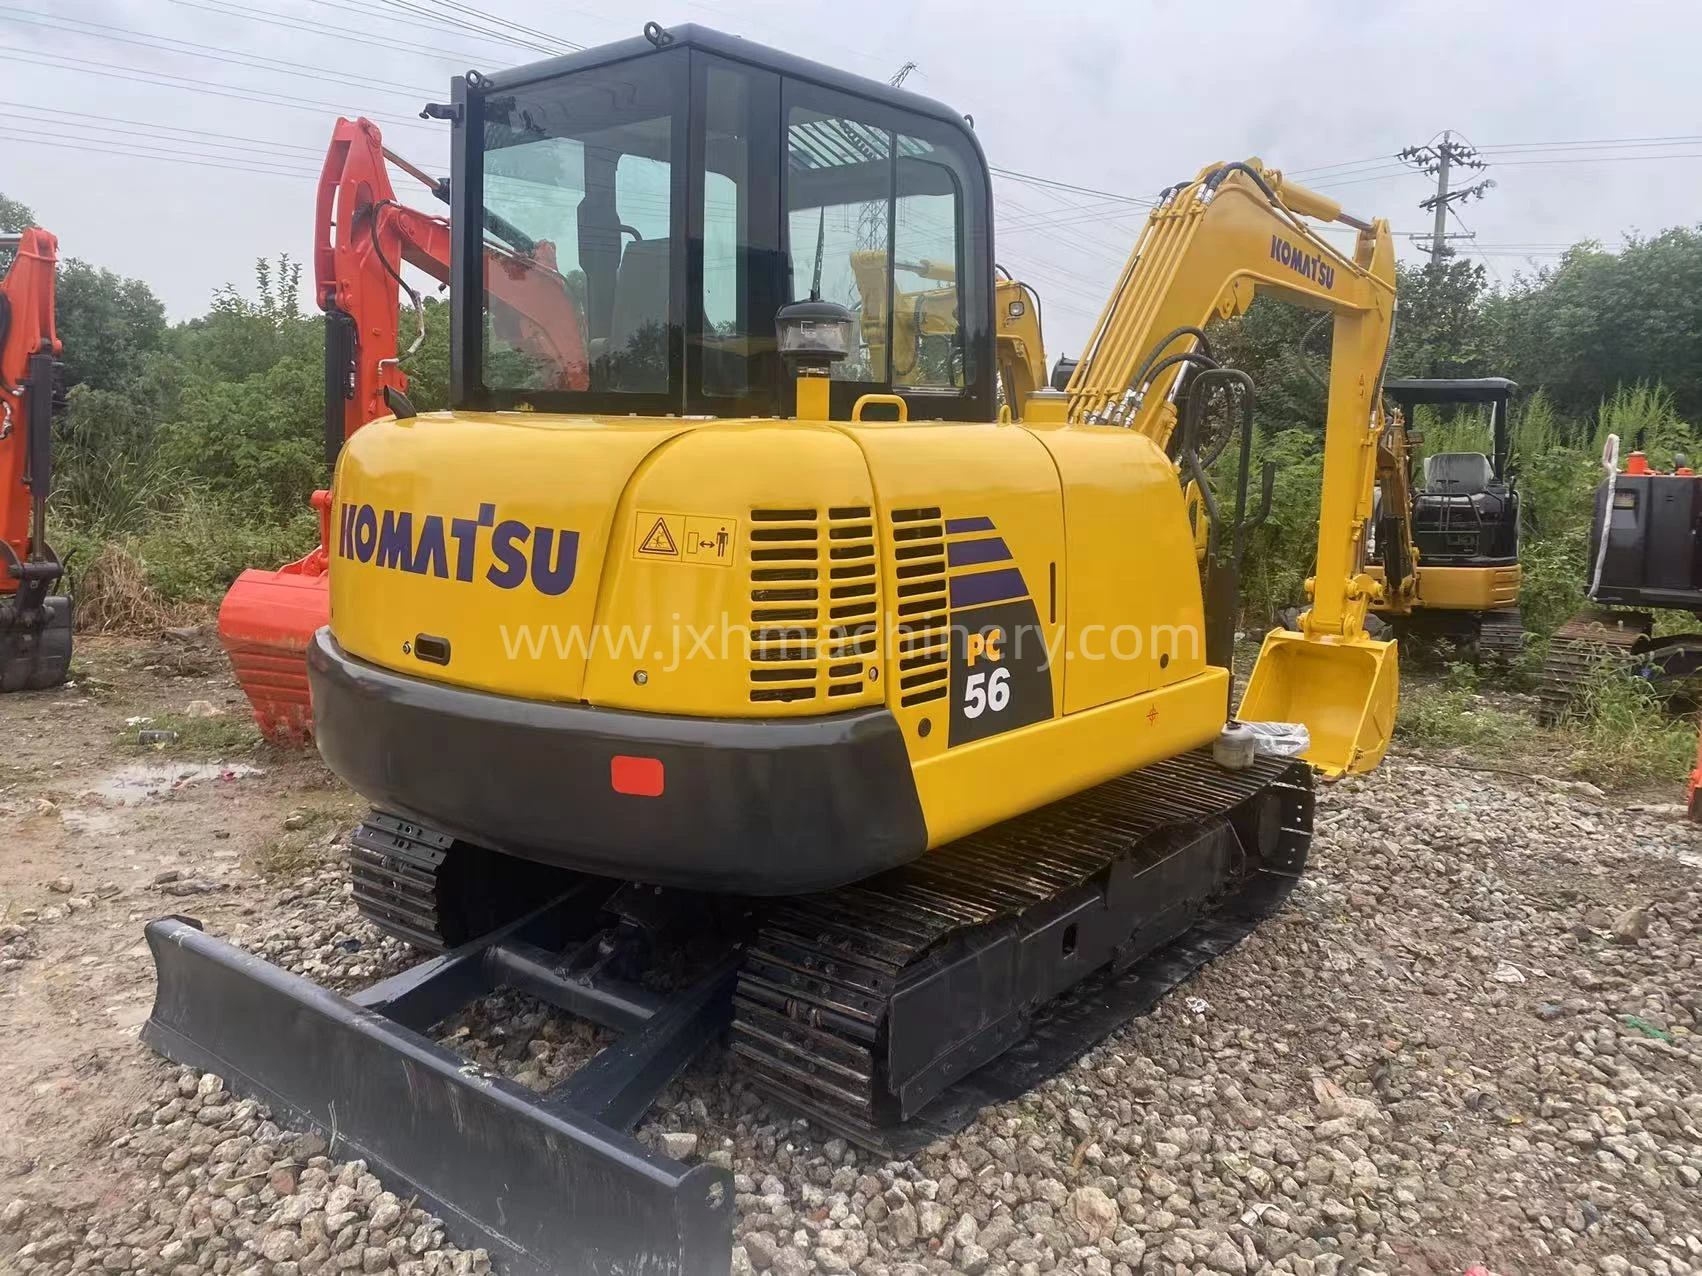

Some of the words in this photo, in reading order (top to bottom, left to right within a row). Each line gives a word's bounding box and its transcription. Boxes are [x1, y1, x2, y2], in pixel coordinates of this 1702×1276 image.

[1270, 234, 1335, 290] KOMATSU
[338, 502, 580, 596] KOMATSU
[967, 628, 1001, 667] PC
[963, 667, 1012, 719] 56
